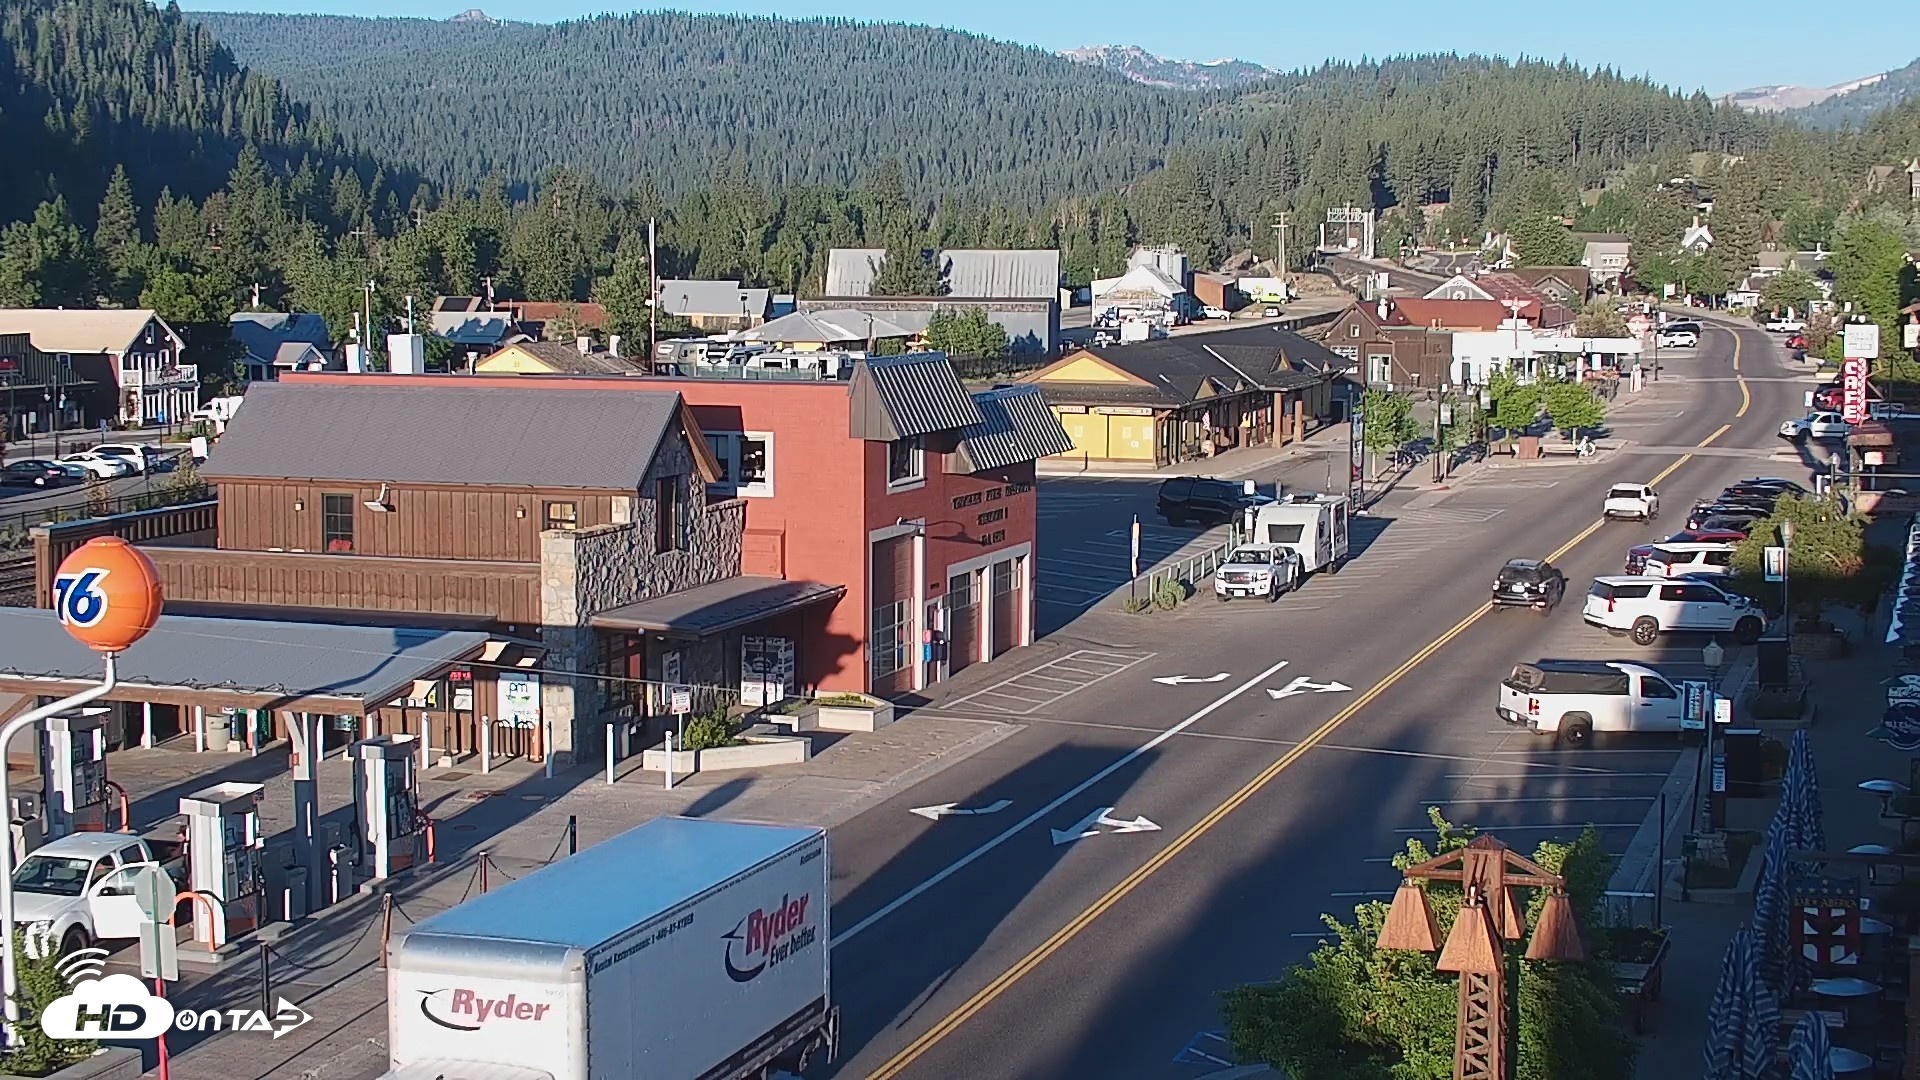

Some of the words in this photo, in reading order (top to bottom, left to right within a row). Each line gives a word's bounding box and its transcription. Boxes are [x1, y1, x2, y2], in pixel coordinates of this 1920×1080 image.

[1844, 361, 1858, 419] CAFE
[54, 570, 105, 625] 76
[745, 892, 809, 957] Ryder
[769, 942, 790, 968] Ever
[790, 925, 816, 956] better
[451, 988, 550, 1023] Ryder
